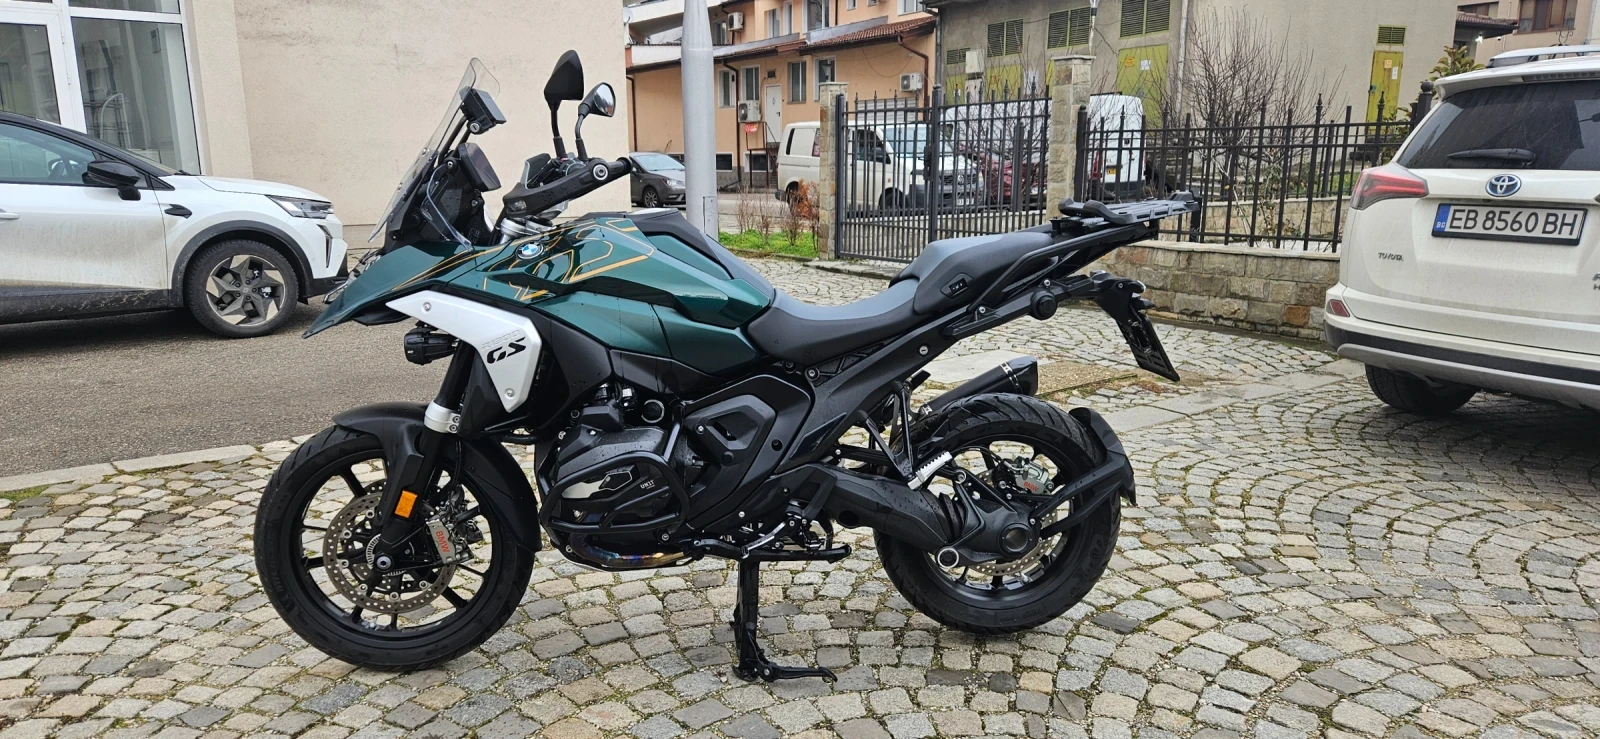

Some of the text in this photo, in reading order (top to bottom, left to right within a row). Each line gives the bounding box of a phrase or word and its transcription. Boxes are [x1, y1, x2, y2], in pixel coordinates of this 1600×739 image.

[1436, 221, 1446, 229] BG
[1449, 208, 1579, 236] EB 8560 BH
[1377, 252, 1404, 261] TOYOTA
[486, 336, 527, 365] GS
[1023, 481, 1039, 492] BMW
[435, 530, 451, 553] BMW
